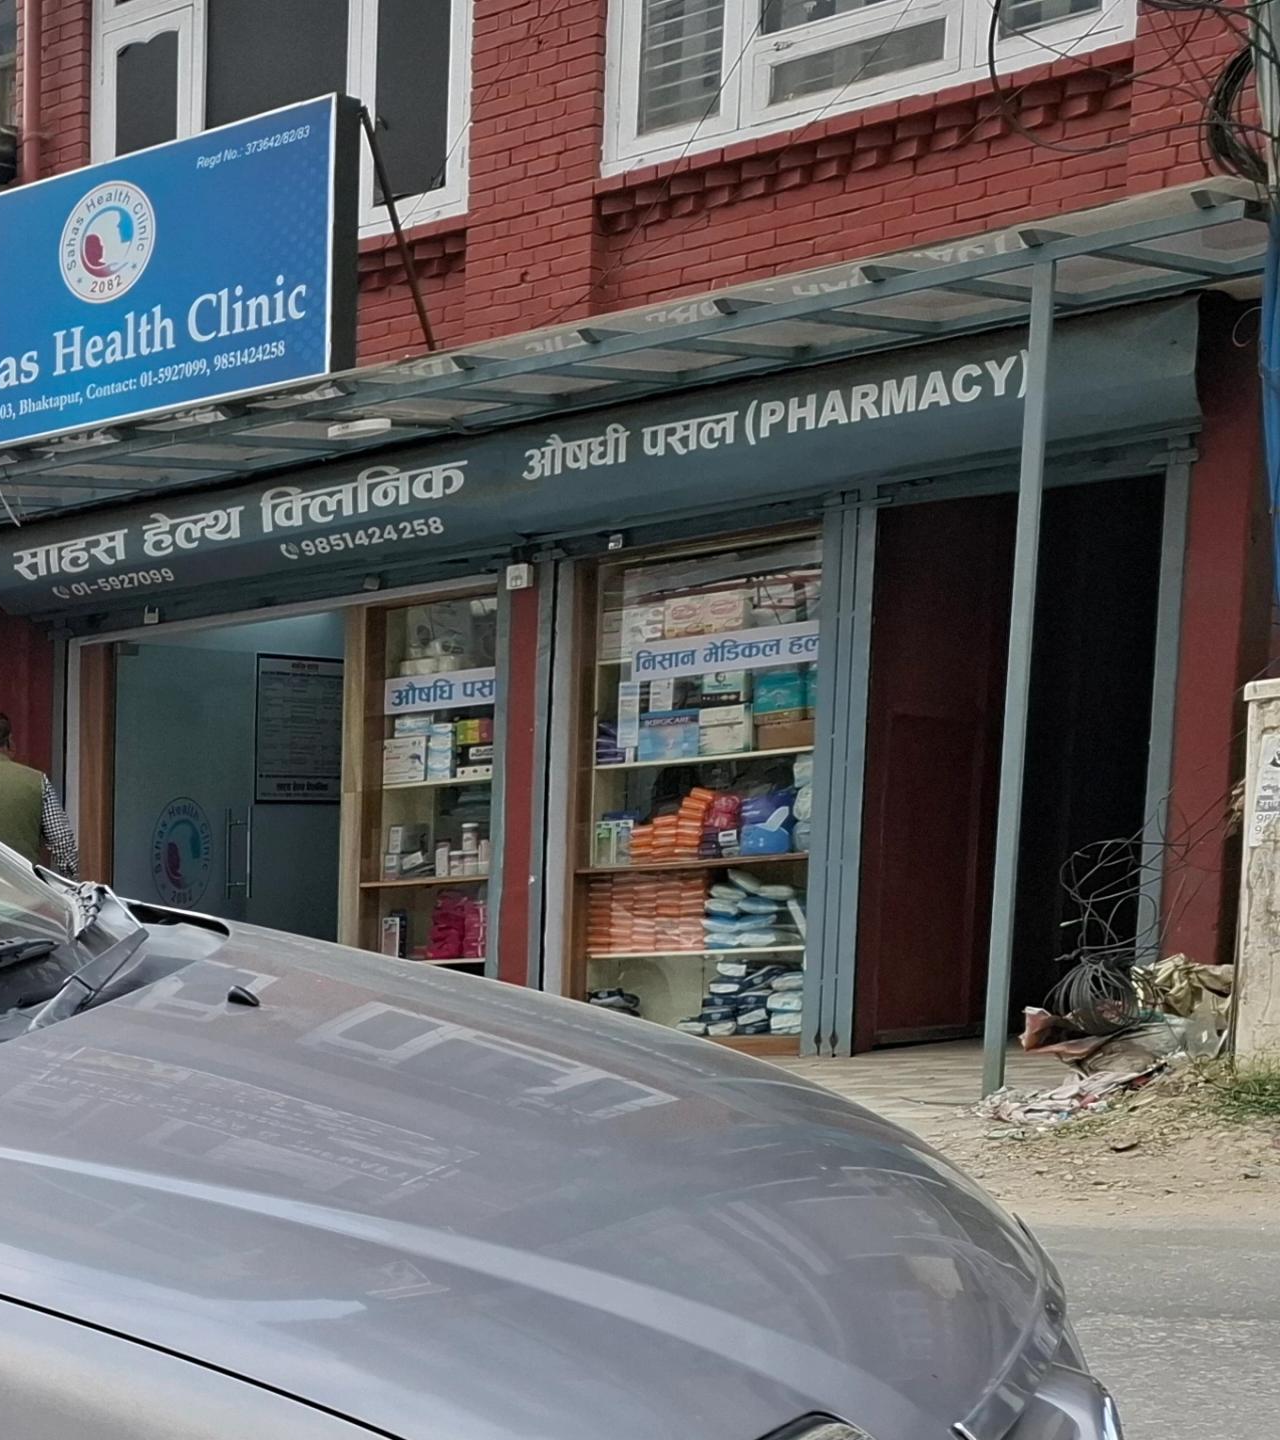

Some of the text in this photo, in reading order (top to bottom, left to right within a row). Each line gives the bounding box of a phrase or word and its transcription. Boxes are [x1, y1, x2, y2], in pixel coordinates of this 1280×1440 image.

[196, 151, 222, 169] Regd
[66, 187, 149, 271] Sahas Health Clinic
[89, 274, 123, 293] 2082
[52, 303, 176, 377] Health
[187, 274, 307, 343] Clinic
[19, 387, 84, 416] Bhaktapur,
[86, 376, 137, 400] Contact:
[140, 357, 211, 388] 01-5927099,
[213, 340, 285, 371] 9851424258
[13, 528, 129, 582] साहस
[142, 505, 245, 559] हेल्थ
[260, 460, 469, 534] क्लिनिक
[641, 410, 739, 458] पसल
[744, 348, 1029, 447] (PHARMACY)
[302, 515, 445, 557] 9851424258
[71, 566, 175, 597] 01-5927099
[635, 648, 698, 673] निसान
[703, 638, 784, 664] मेडिकल
[462, 678, 496, 698] पस
